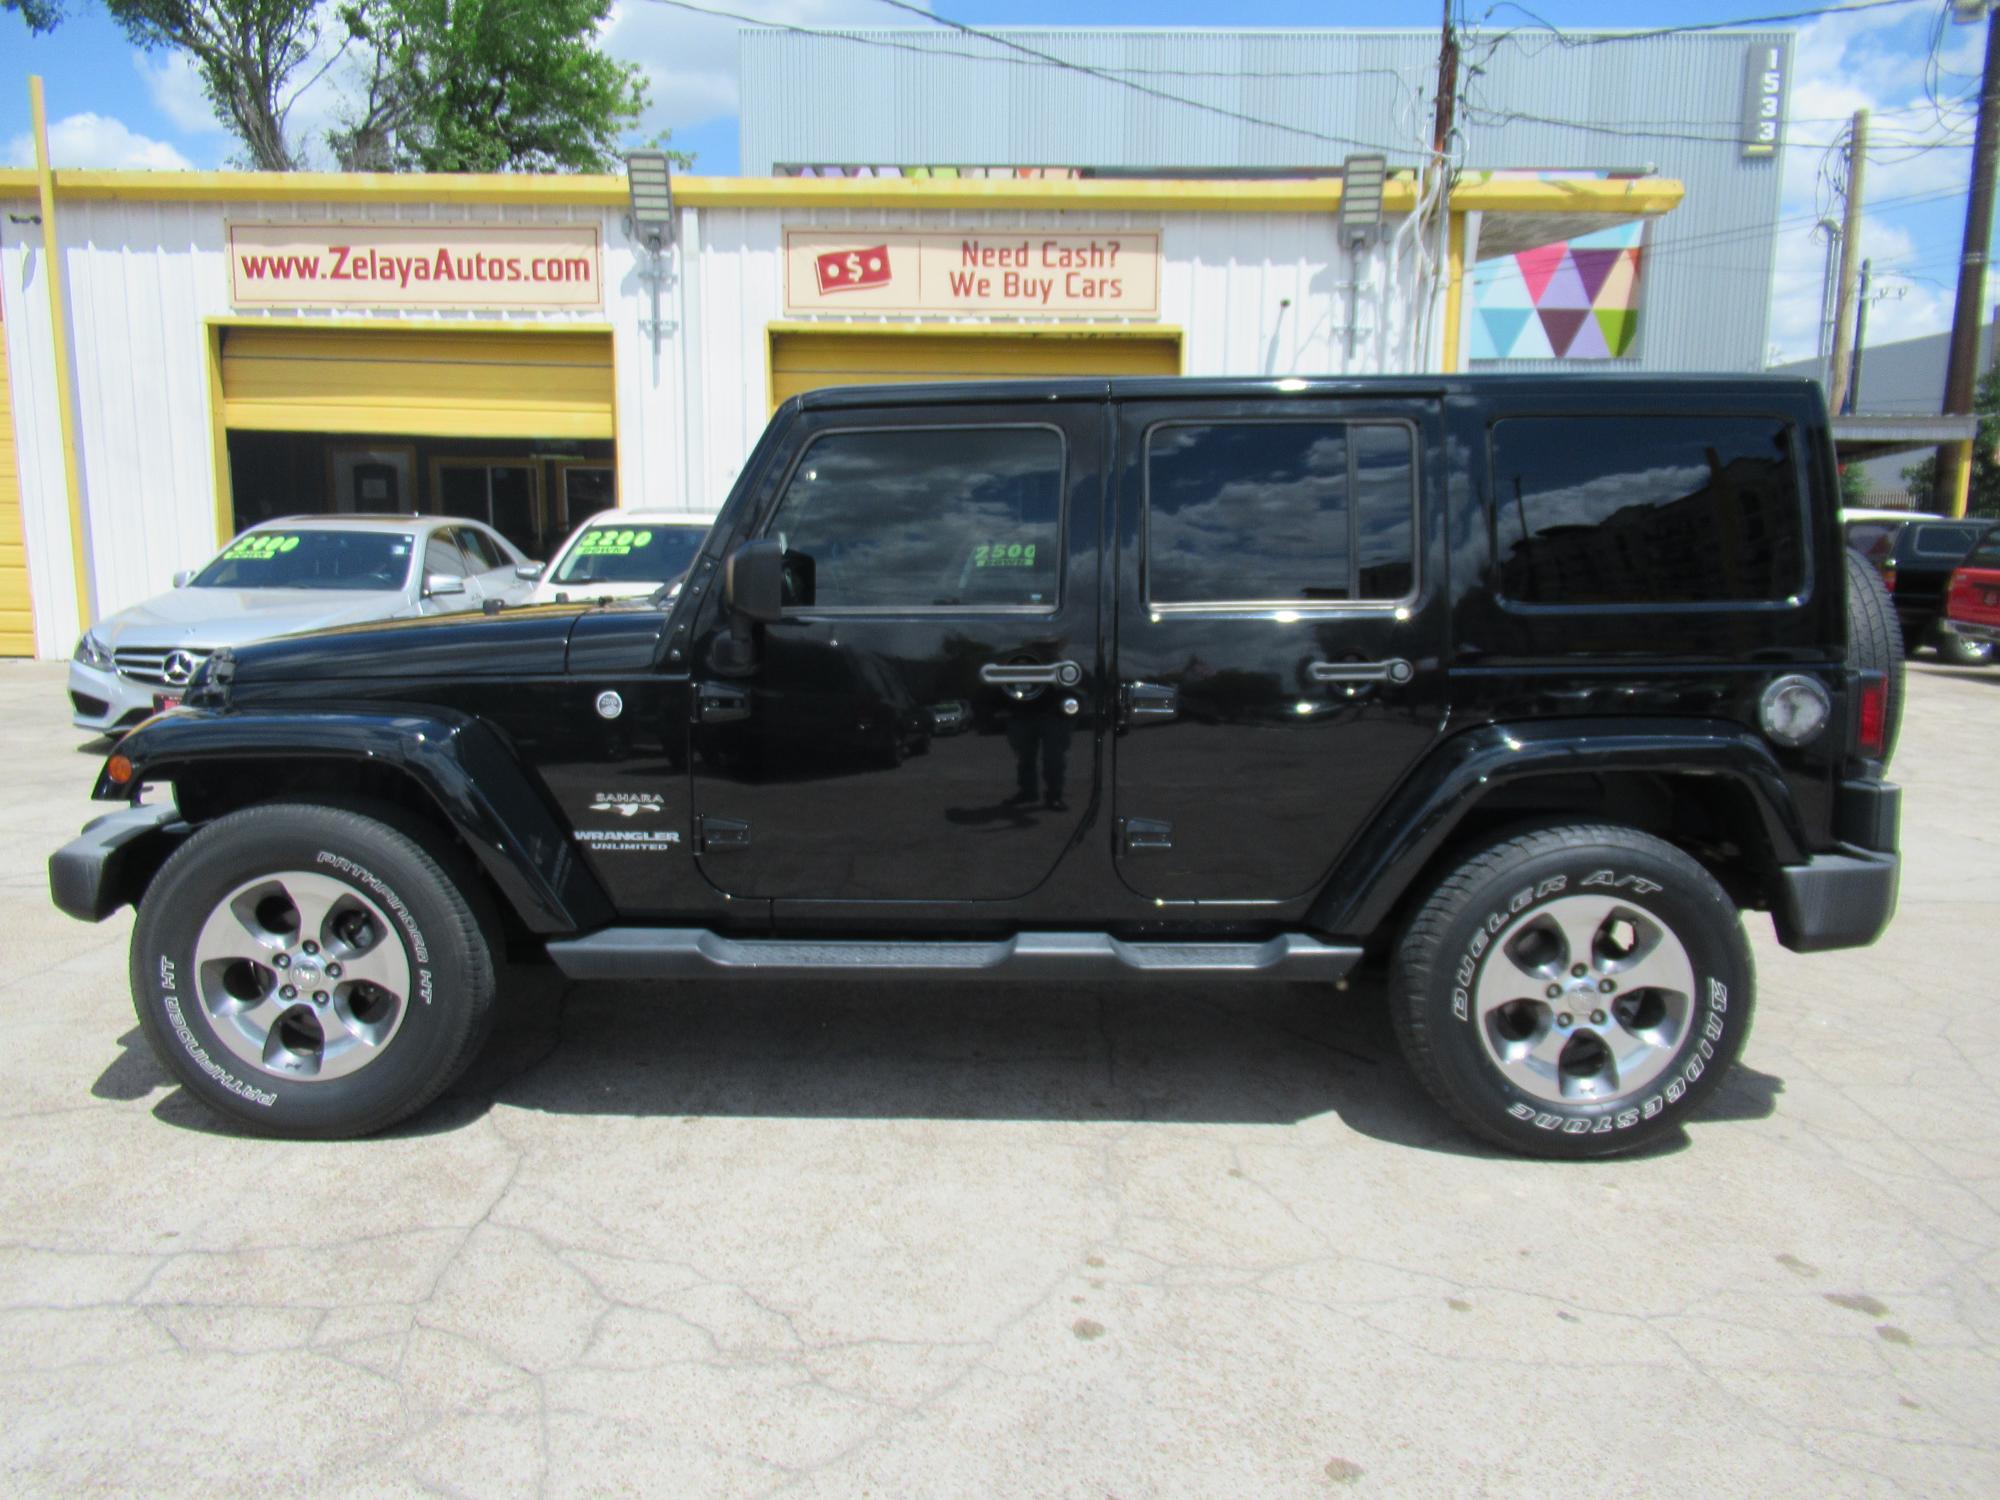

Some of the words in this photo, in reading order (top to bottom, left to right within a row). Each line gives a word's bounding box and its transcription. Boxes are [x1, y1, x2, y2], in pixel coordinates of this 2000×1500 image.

[1759, 48, 1780, 141] 1533
[241, 246, 591, 289] www.ZelayaAutos.com
[961, 240, 1030, 268] Need
[1041, 241, 1122, 268] Cash?
[949, 271, 991, 298] We
[1003, 272, 1055, 304] Buy
[1065, 272, 1123, 298] Cars
[595, 792, 665, 803] SAHARA
[573, 830, 680, 843] WRANGLER
[591, 843, 668, 851] UNLIMITED
[316, 850, 429, 963] PATHFINDER
[419, 969, 433, 1005] HT
[1453, 875, 1568, 1022] DUELER
[1580, 870, 1664, 893] A/T
[160, 955, 176, 990] HT
[165, 996, 278, 1107] PATHFINDER
[1507, 976, 1729, 1134] BRIDGESTONE
